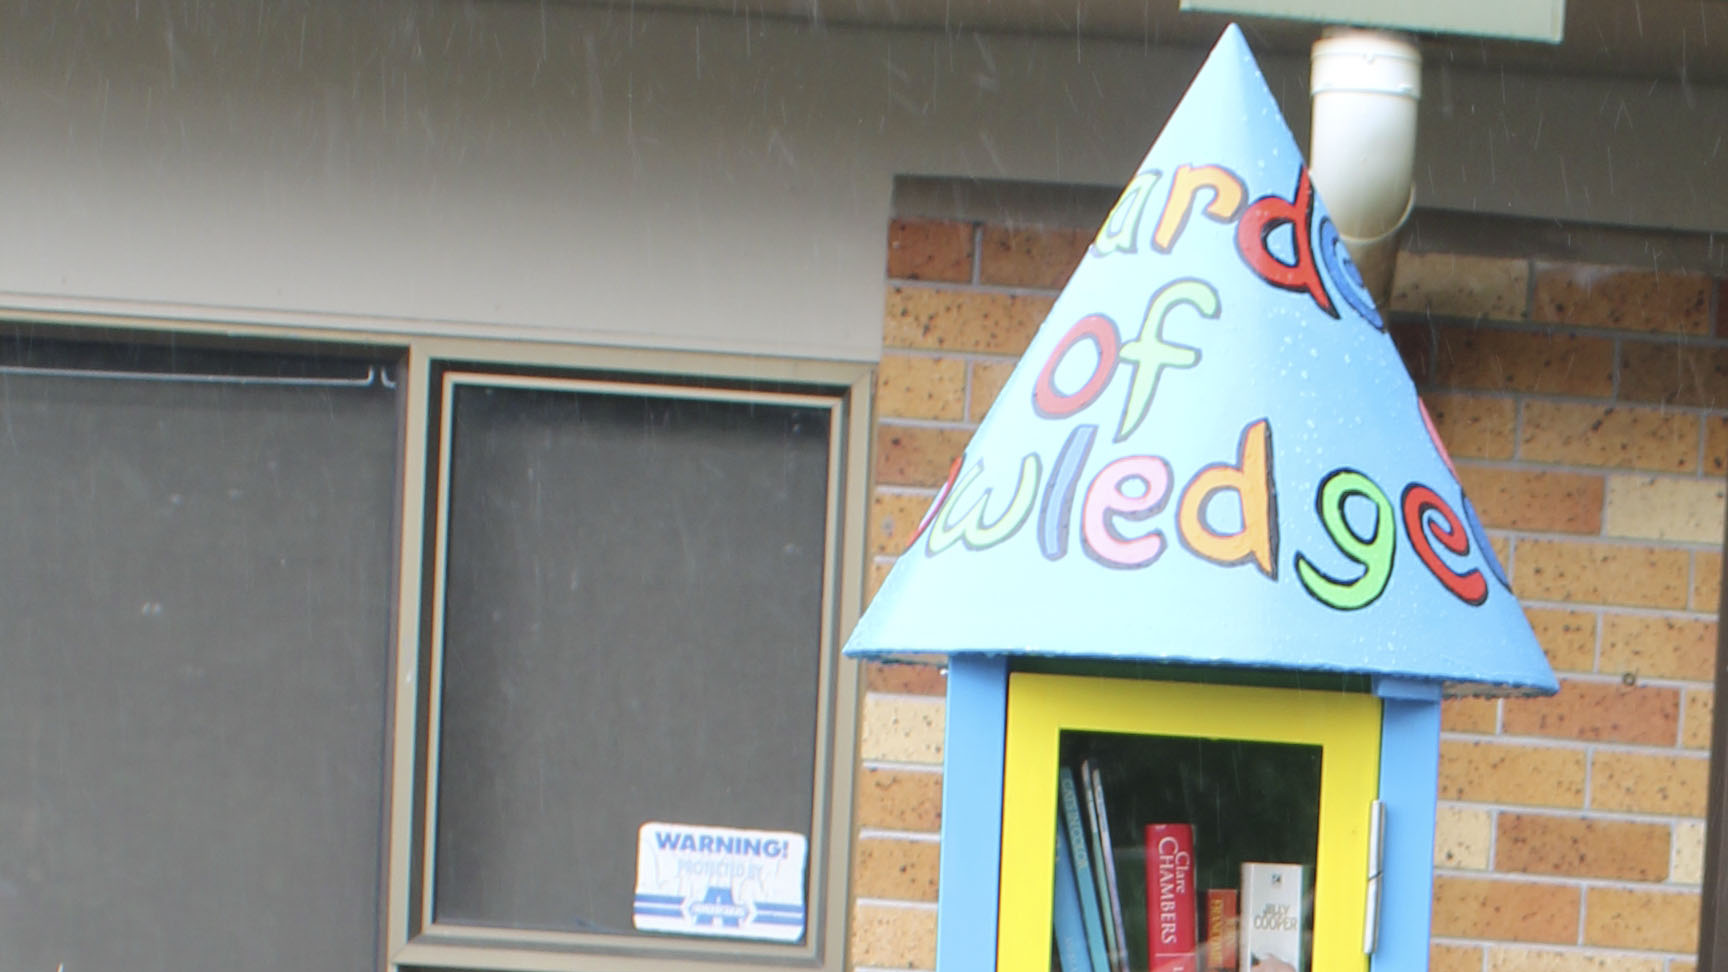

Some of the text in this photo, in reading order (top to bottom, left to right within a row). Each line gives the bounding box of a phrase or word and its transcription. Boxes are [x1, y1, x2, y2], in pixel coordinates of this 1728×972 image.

[1032, 278, 1220, 442] of
[903, 418, 1489, 610] wledge
[656, 830, 790, 859] WARNING!
[1175, 851, 1190, 894] Clare
[1157, 836, 1178, 945] CHAMBERS
[1253, 915, 1297, 931] COOPER
